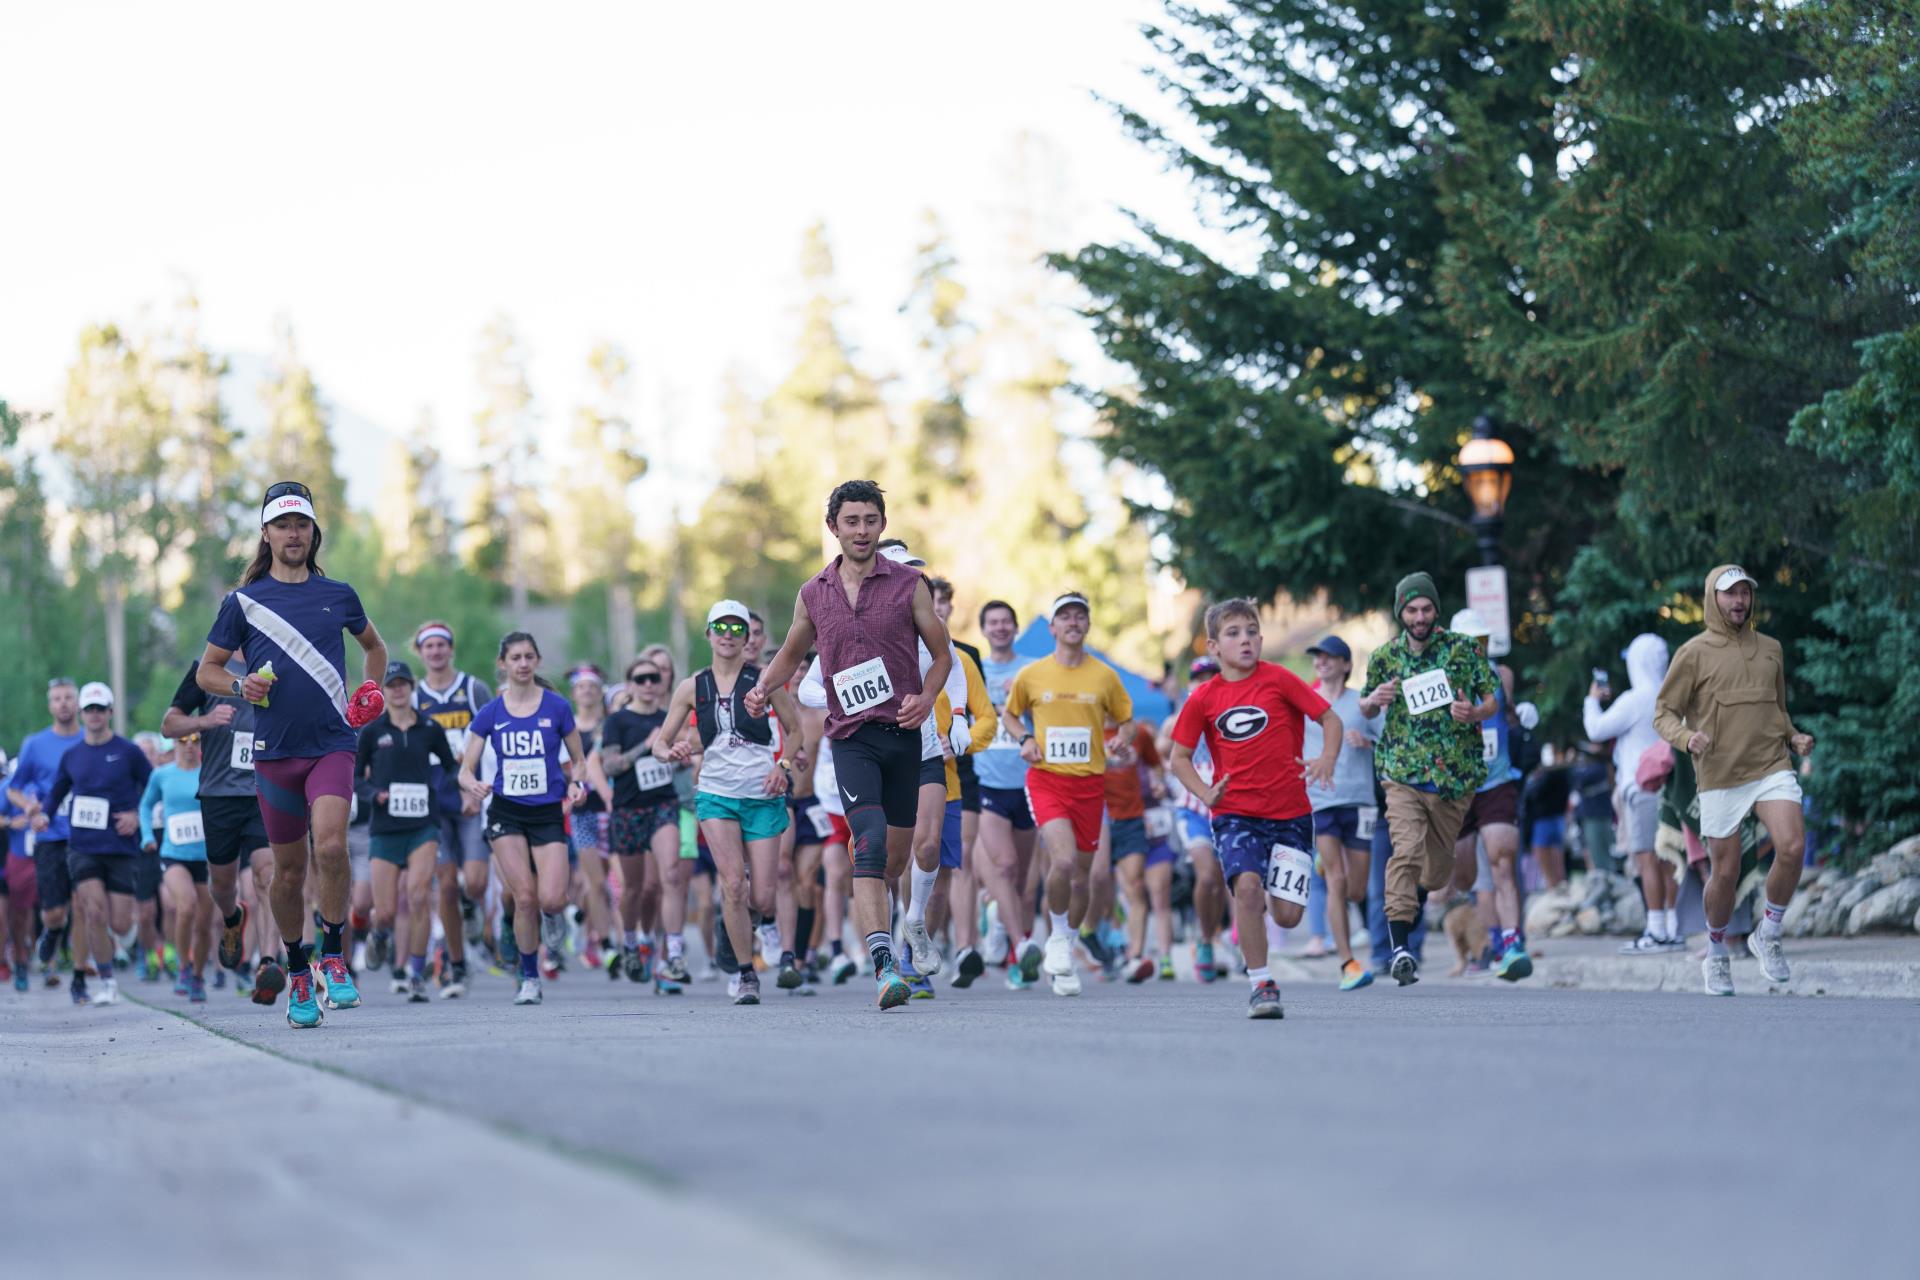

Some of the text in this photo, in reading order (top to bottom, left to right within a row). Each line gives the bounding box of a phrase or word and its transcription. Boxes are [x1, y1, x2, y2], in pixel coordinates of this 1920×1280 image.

[278, 500, 302, 508] USA
[842, 675, 890, 709] 1064
[1410, 682, 1449, 709] 1128
[1215, 706, 1268, 741] G
[501, 730, 546, 756] USA
[1050, 742, 1088, 758] 1140
[510, 773, 539, 790] 785
